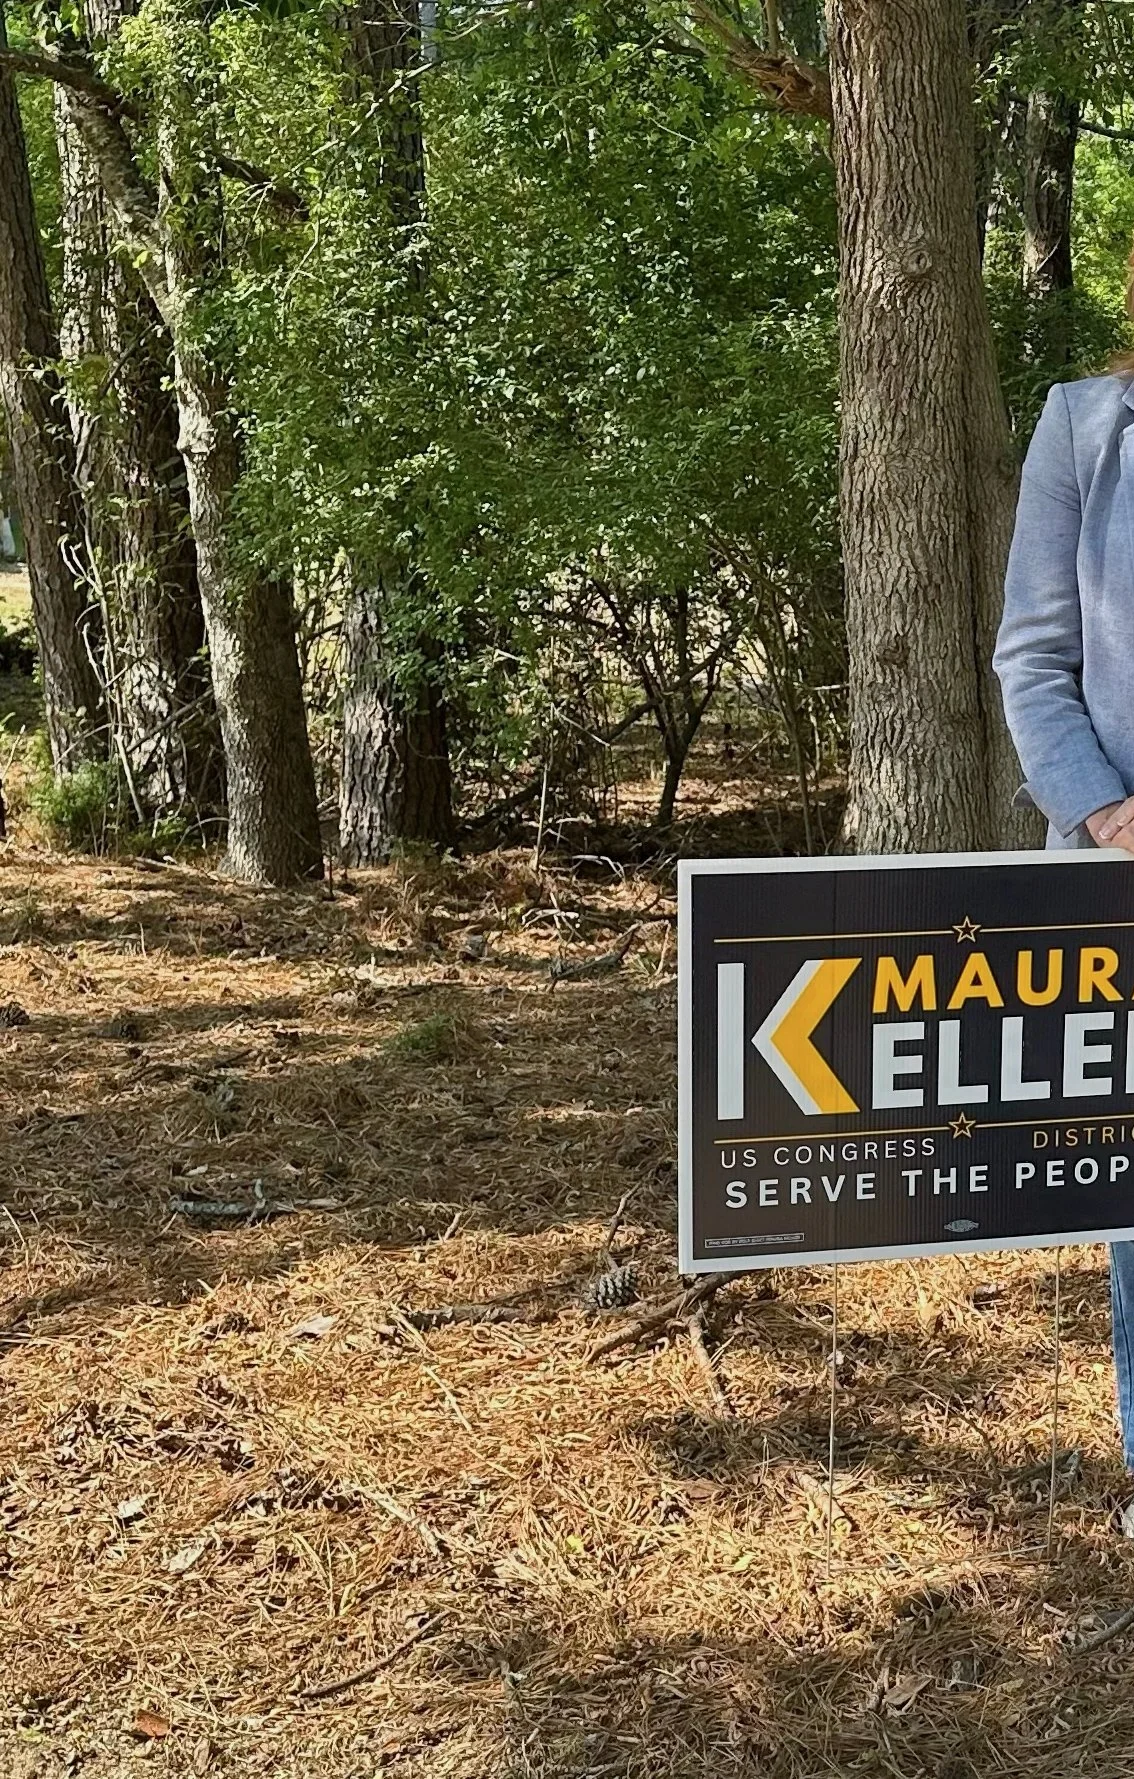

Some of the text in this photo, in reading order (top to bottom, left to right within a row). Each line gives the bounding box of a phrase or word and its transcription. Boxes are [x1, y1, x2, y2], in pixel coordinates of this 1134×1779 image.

[721, 1138, 936, 1170] US CONGRESS
[725, 1172, 876, 1209] SERVE
[901, 1165, 989, 1196] THE
